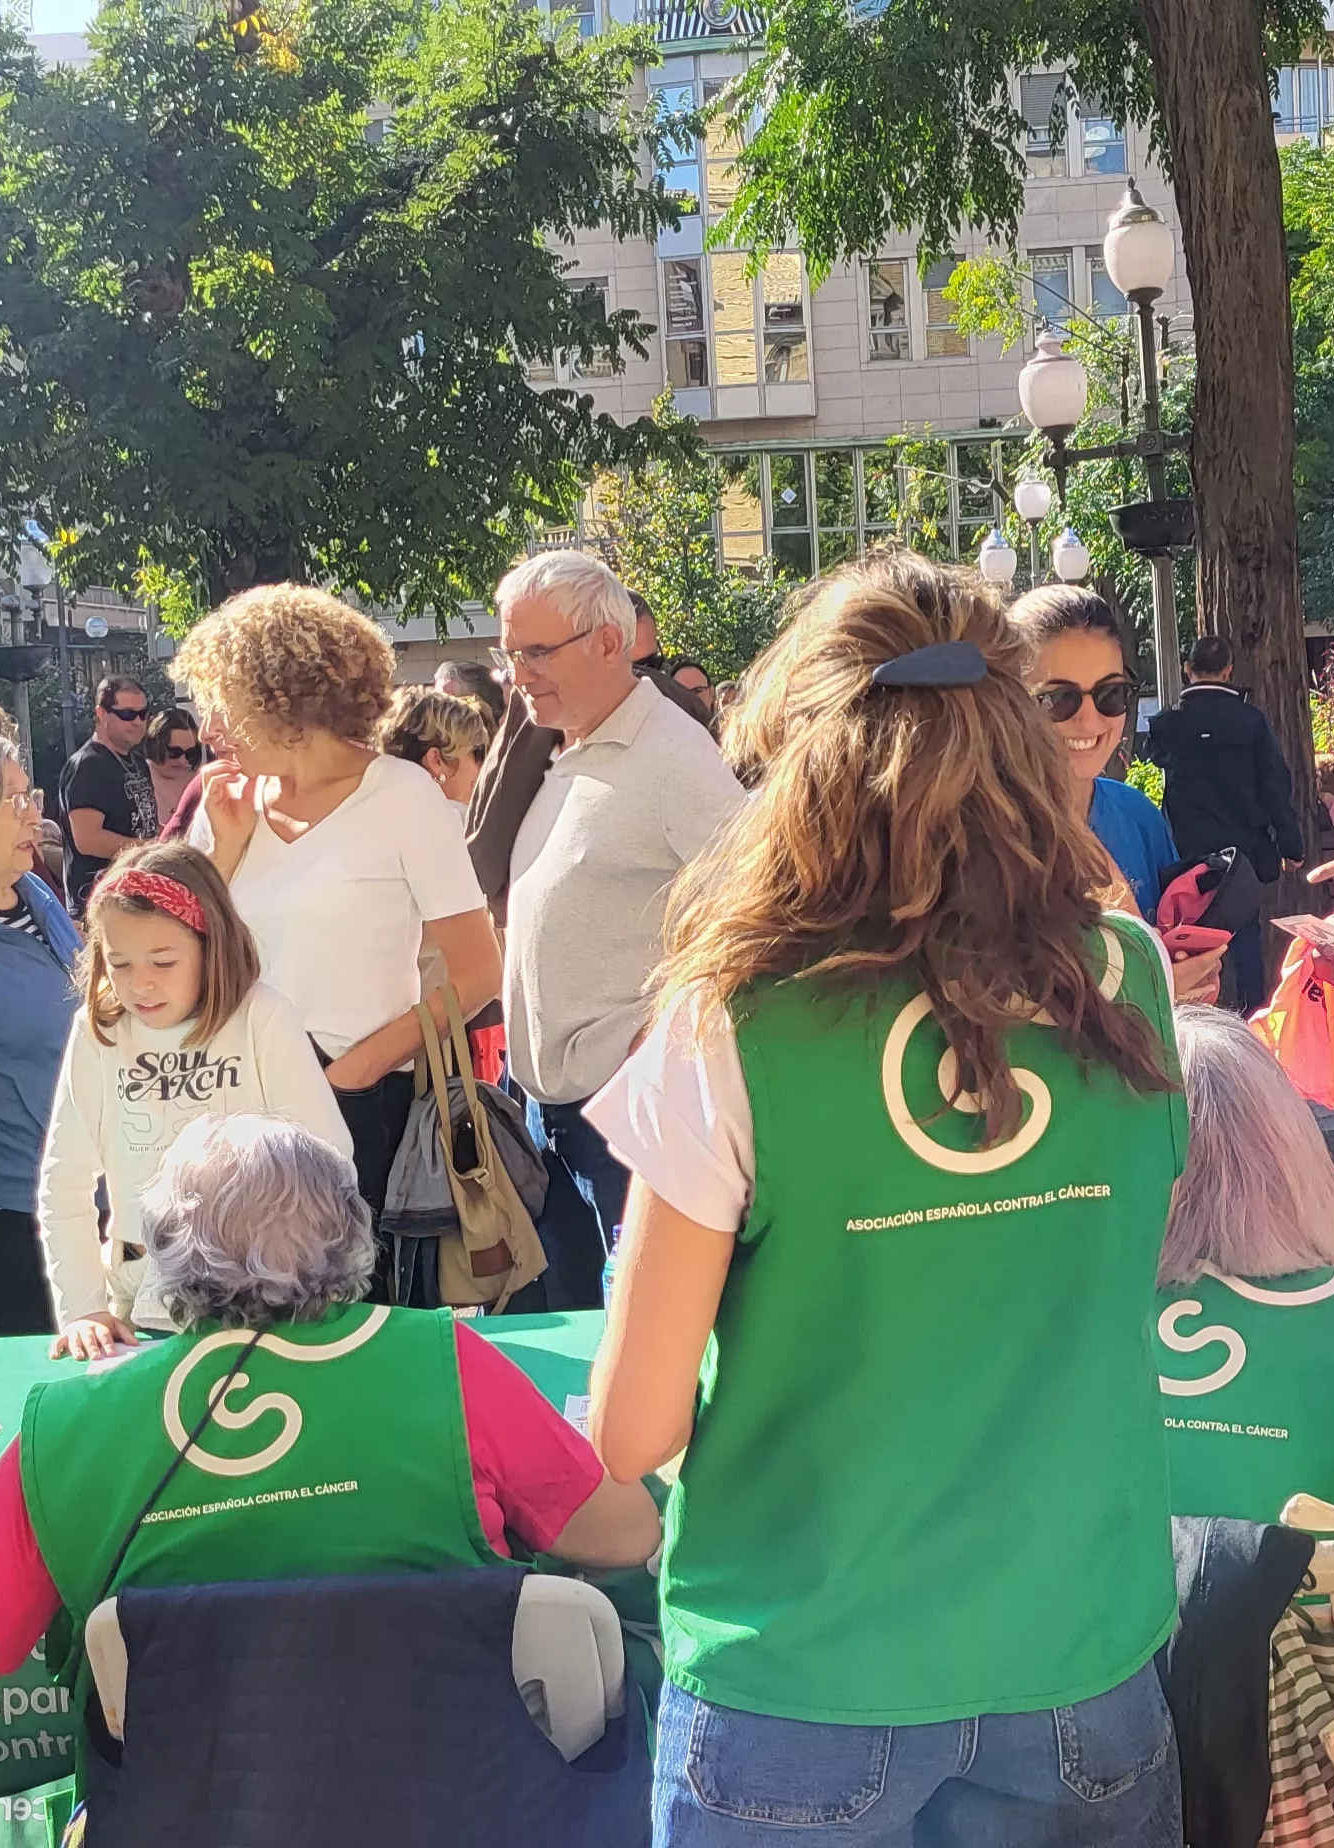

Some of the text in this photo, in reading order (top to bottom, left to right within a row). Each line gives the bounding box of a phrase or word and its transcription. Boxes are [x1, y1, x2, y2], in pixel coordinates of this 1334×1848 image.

[846, 1184, 1111, 1231] ASOCIACIÓN ESPAÑOLA CONTRA EL CÁNCER
[1186, 1419, 1231, 1433] CONTRA
[1231, 1424, 1245, 1434] EL
[1246, 1424, 1289, 1439] CÁNCER
[255, 1490, 299, 1505] CONTRA
[300, 1487, 314, 1498] EL
